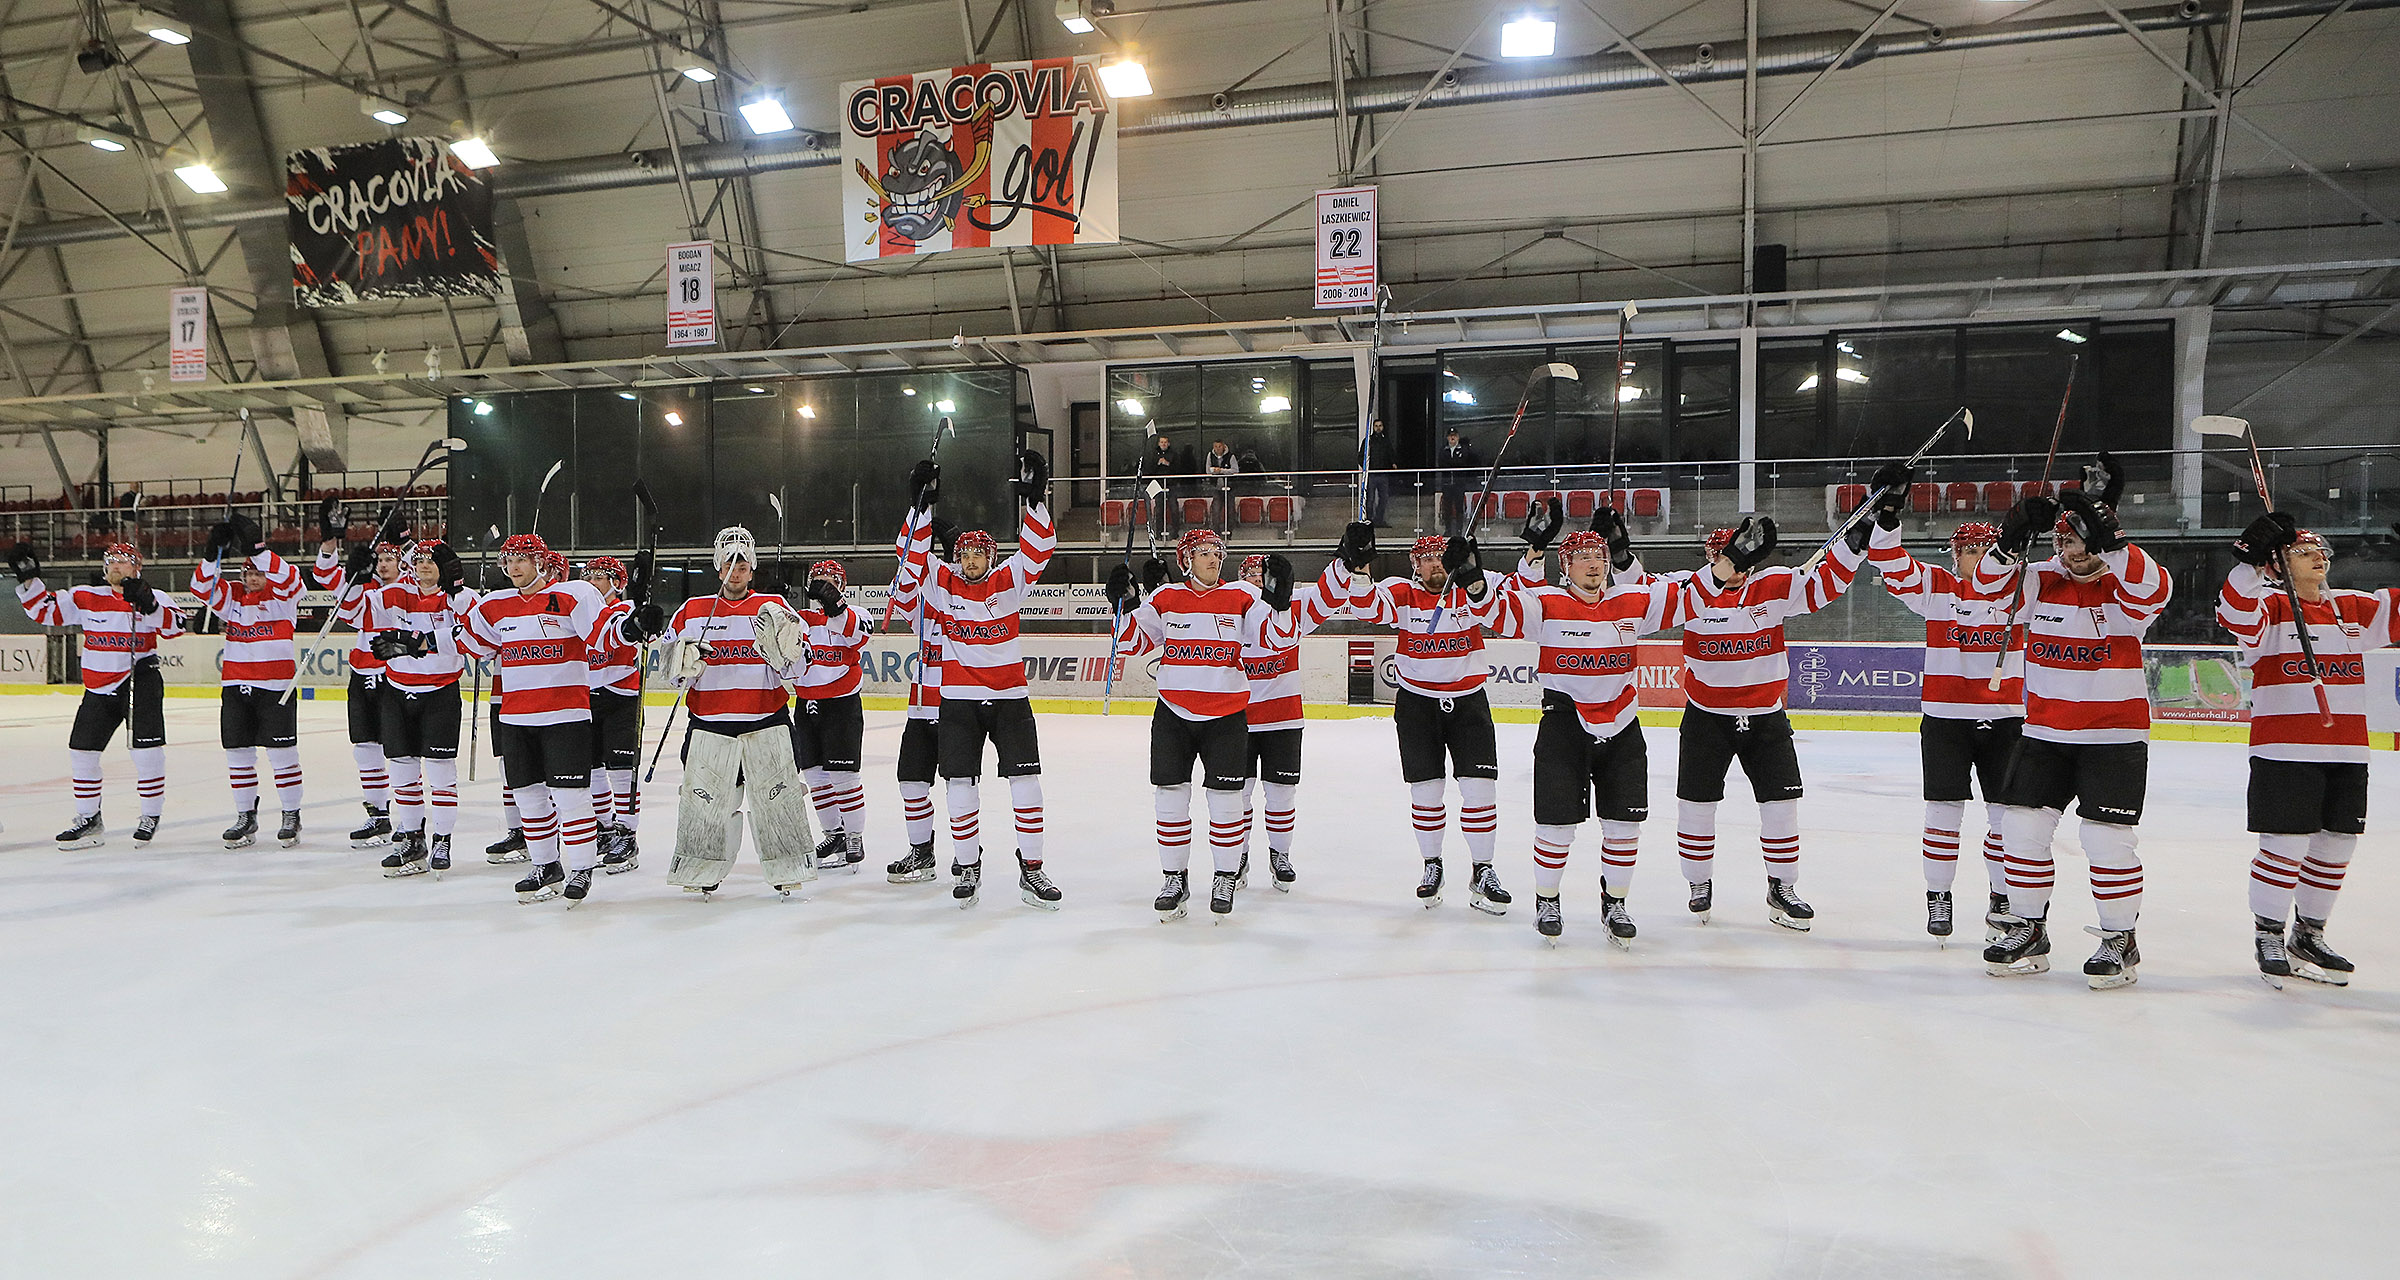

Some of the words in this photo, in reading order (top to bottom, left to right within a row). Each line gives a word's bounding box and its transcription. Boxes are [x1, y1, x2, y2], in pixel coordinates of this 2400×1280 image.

[847, 63, 1110, 138] CRACOVIA
[967, 112, 1107, 235] gol!
[307, 152, 459, 235] CRACOVIA
[1333, 197, 1360, 208] DANIEL
[1321, 211, 1371, 225] LASZKIEWICZ
[357, 205, 456, 280] PANY!
[1330, 228, 1362, 259] 22
[678, 250, 702, 260] BOGDAN
[680, 277, 701, 303] 18
[1323, 289, 1343, 299] 2006
[1349, 287, 1368, 297] 2014
[182, 321, 195, 342] 17
[674, 329, 689, 339] 1964
[545, 594, 561, 613] A
[1075, 606, 1108, 615] 4MOVE
[2034, 615, 2065, 624] TRUE
[1165, 645, 1236, 661] OMARCH
[1698, 635, 1772, 655] COMARCH
[2031, 642, 2112, 663] OMARCH
[1636, 666, 1681, 689] NIK
[2162, 709, 2240, 721] www.interhall.pl
[2099, 806, 2137, 816] TRUE
